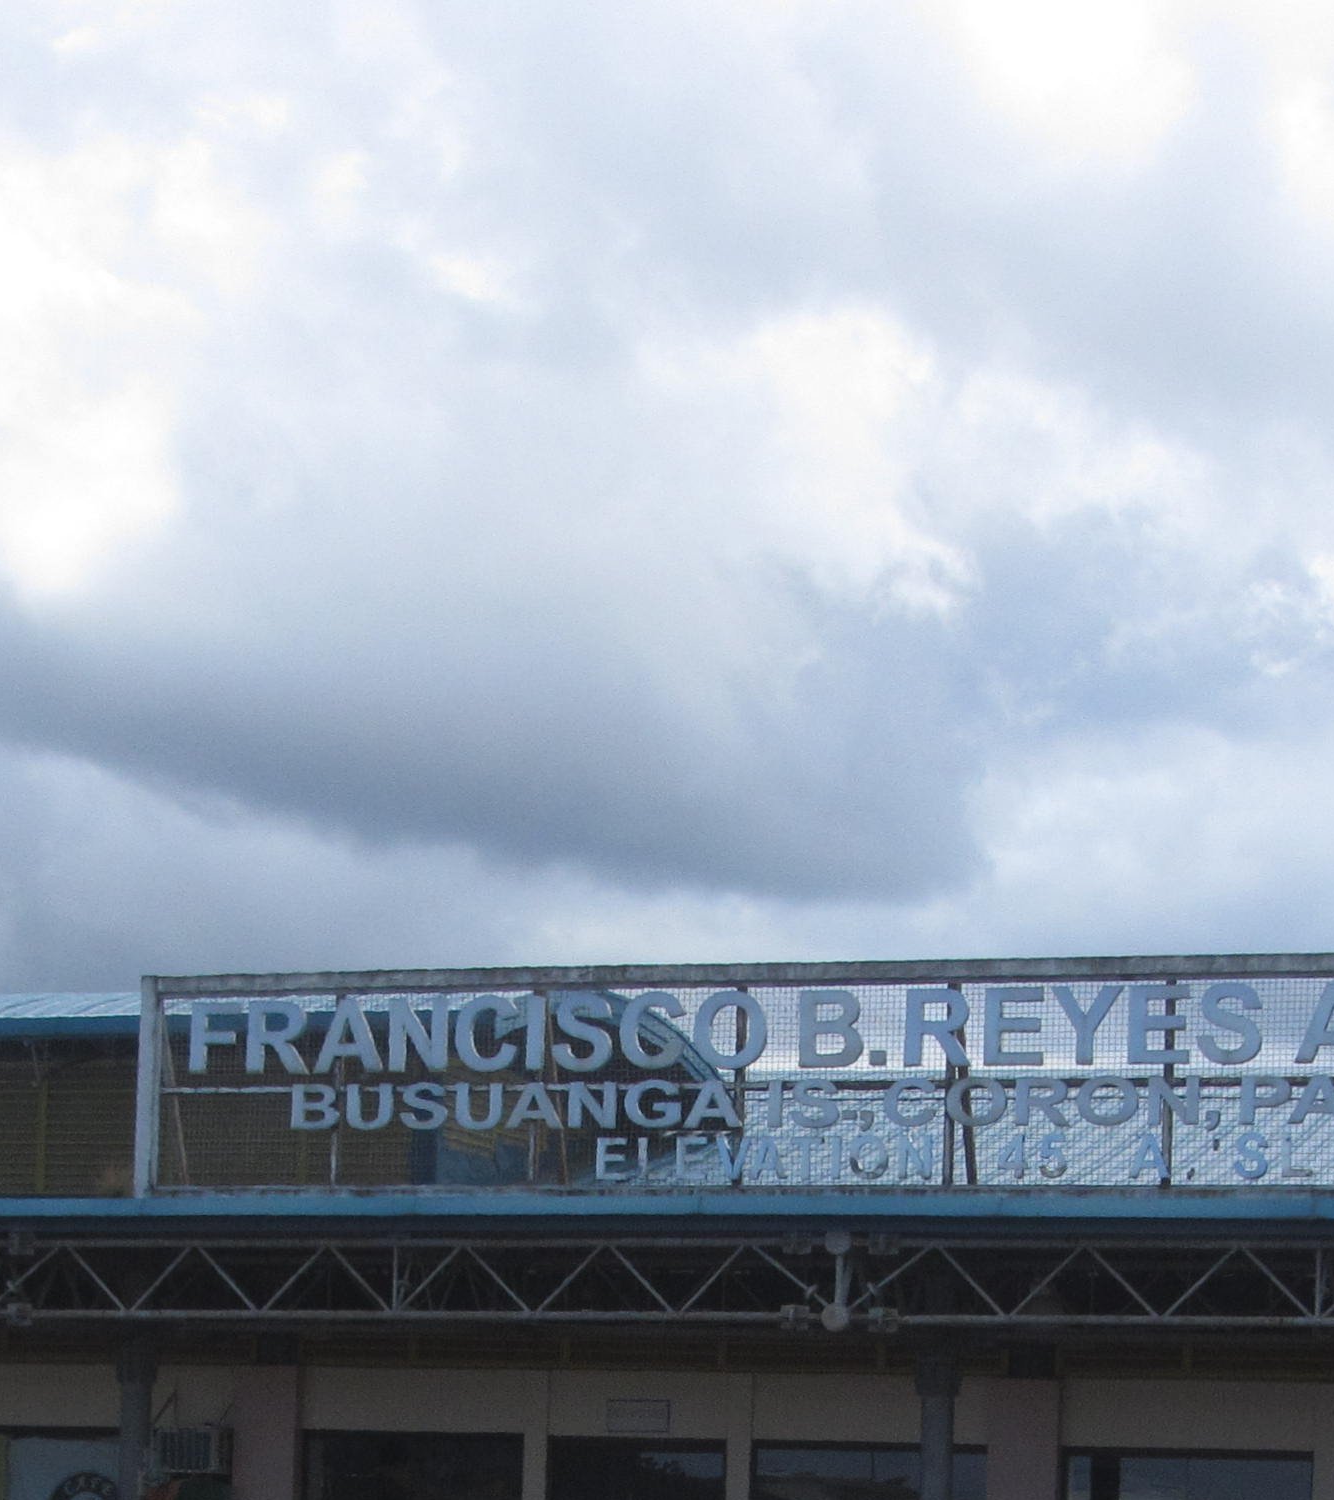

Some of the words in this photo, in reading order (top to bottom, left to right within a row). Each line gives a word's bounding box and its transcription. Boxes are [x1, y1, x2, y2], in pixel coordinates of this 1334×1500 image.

[188, 990, 766, 1075] FRANCISCO
[290, 1079, 741, 1131] BUSUANGA
[595, 1135, 934, 1180] ELEVATION
[998, 1134, 1069, 1179] 45
